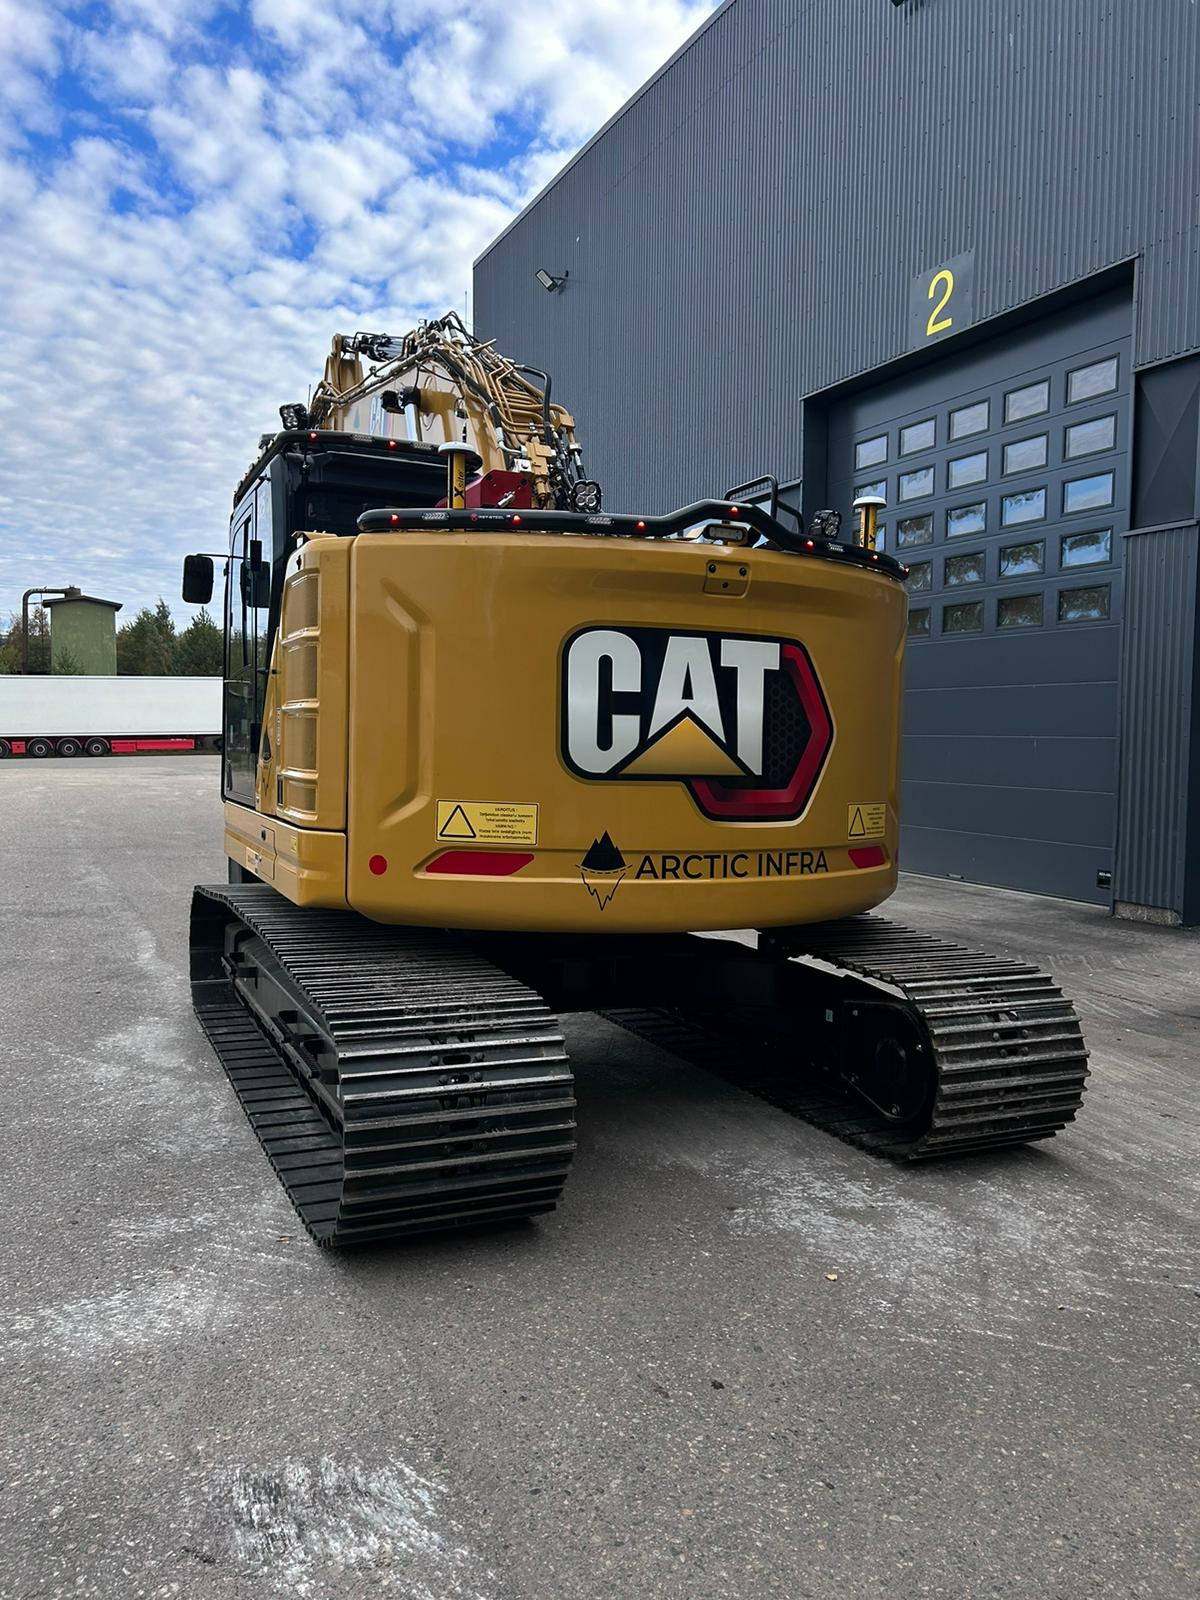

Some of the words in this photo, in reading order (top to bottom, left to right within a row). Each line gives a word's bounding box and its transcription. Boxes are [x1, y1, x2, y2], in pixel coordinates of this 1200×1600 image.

[927, 269, 954, 336] 2
[568, 630, 780, 776] CAT
[635, 853, 749, 879] ARCTIC
[758, 850, 829, 876] INFRA
